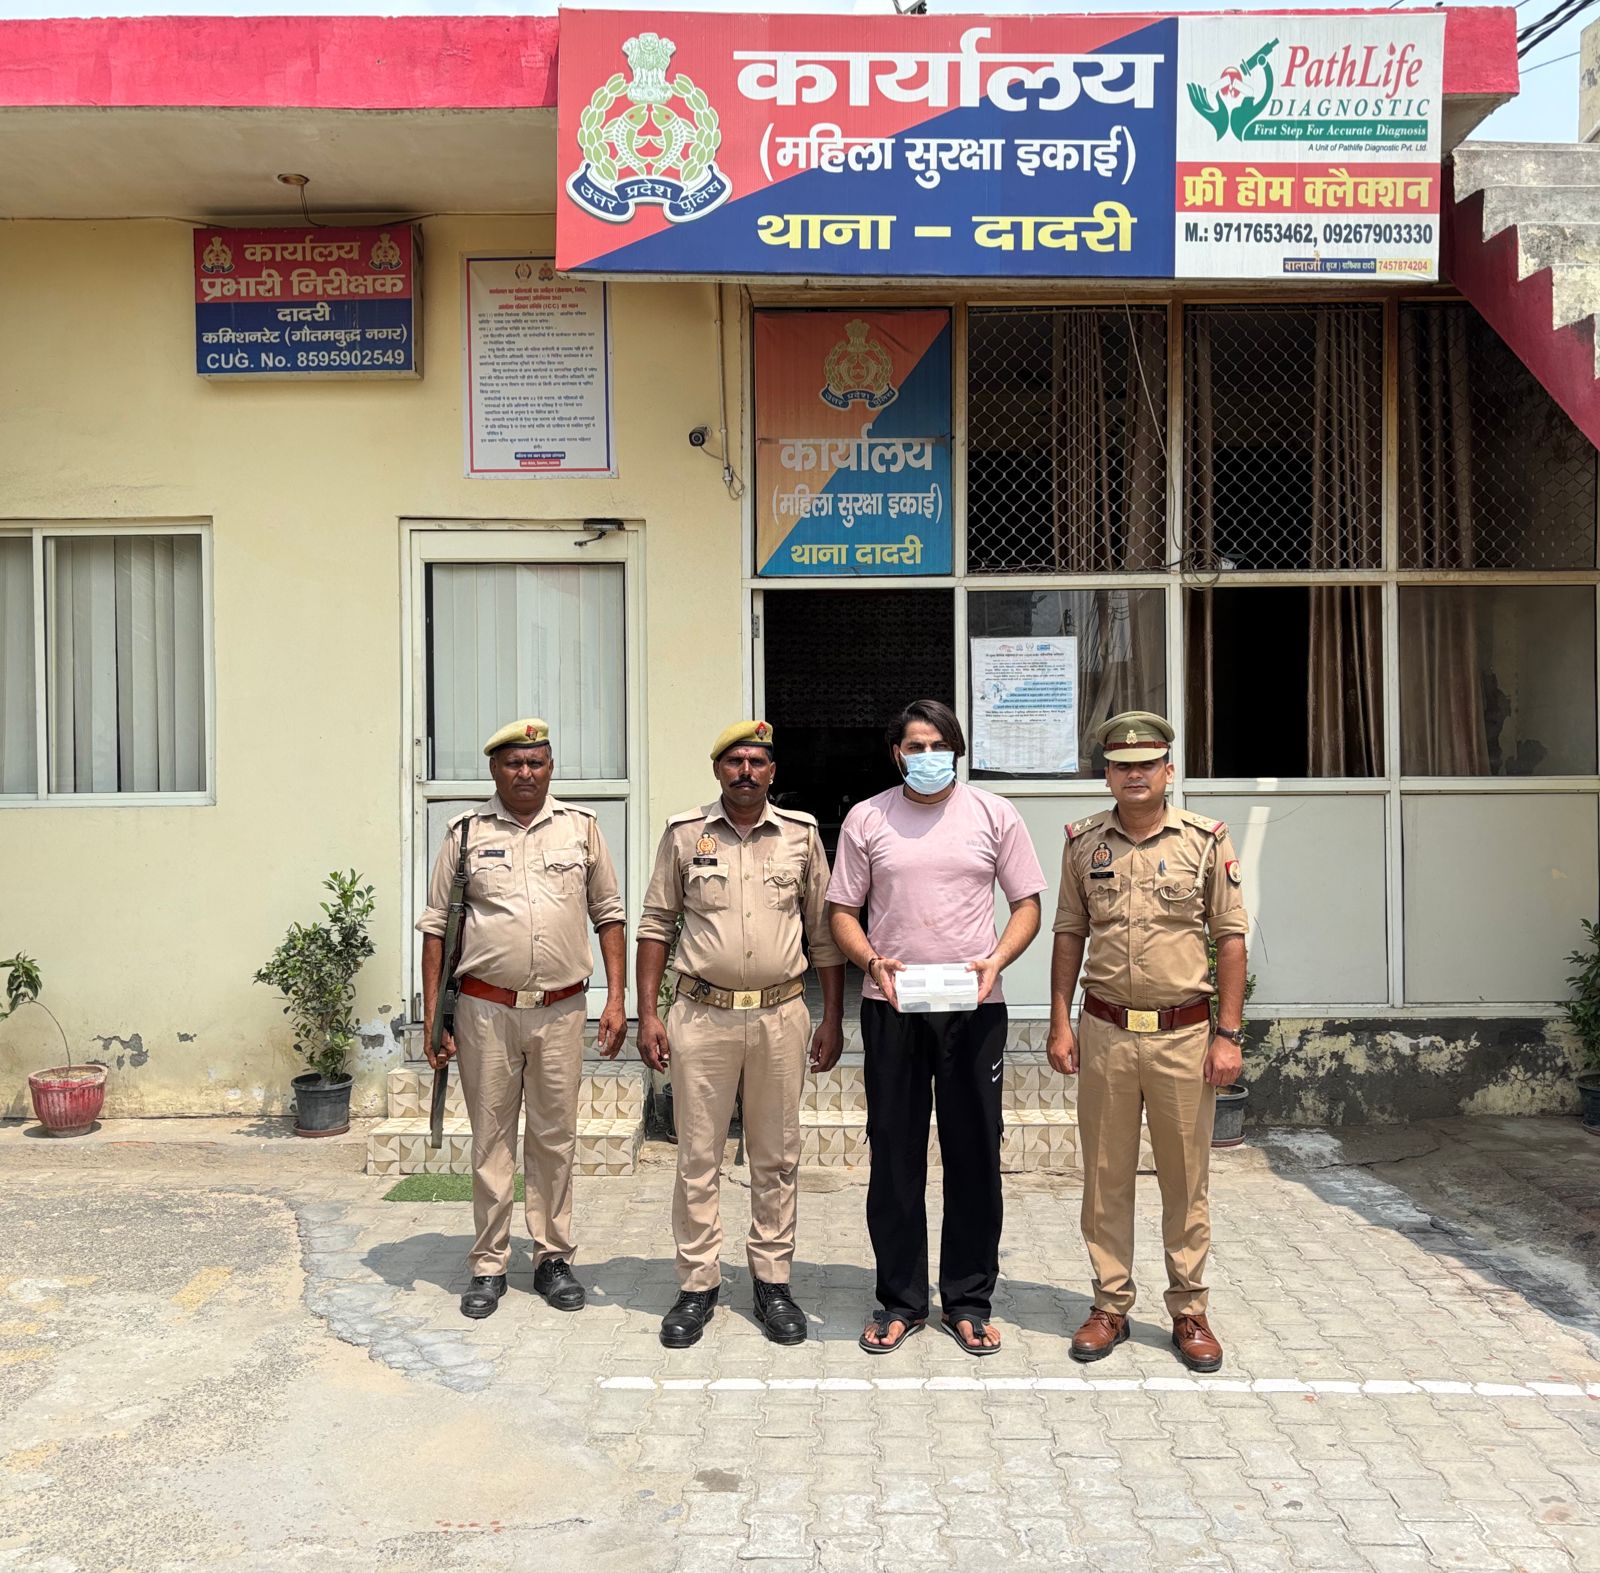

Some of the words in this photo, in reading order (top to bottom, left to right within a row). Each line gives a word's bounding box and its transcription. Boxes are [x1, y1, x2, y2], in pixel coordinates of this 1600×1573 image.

[733, 27, 1164, 113] कार्यालय
[1280, 42, 1423, 99] PathLife
[1269, 98, 1430, 117] DIAGNOSTIC
[1254, 123, 1277, 136] First
[1280, 123, 1303, 139] Step
[1307, 123, 1324, 136] For
[1326, 124, 1373, 137] Accurate
[1376, 123, 1426, 139] Diagnosis
[759, 122, 894, 184] (महिला
[905, 138, 1003, 189] सुरक्षा
[1015, 125, 1137, 185] इकाई)
[1308, 143, 1314, 151] A
[1315, 143, 1329, 151] Unit
[1330, 143, 1337, 151] of
[1338, 143, 1363, 151] Pathlife
[1364, 143, 1399, 152] Diagnostic
[580, 182, 618, 212] उत्तर
[624, 179, 672, 198] प्रदेश
[679, 180, 722, 215] पुलिस
[1183, 166, 1227, 208] फ्री
[1236, 167, 1295, 208] होम
[757, 213, 897, 250] थाना
[972, 200, 1137, 253] दादरी
[1185, 222, 1209, 242] M.:
[1213, 222, 1318, 248] 9717653462,
[1323, 223, 1433, 244] 09267903330
[243, 235, 360, 262] कार्यालय
[200, 268, 283, 302] प्रभारी
[290, 267, 406, 296] निरीक्षक
[277, 302, 331, 322] दादरी
[202, 327, 280, 344] कमिशनरेट
[365, 324, 407, 344] नगर)
[206, 352, 254, 369] CUG.
[261, 352, 291, 368] No.
[297, 349, 404, 367] 8595902549
[779, 423, 935, 473] कार्यालय
[772, 484, 833, 525] (महिला
[838, 492, 882, 528] सुरक्षा
[887, 483, 942, 524] इकाई)
[791, 543, 849, 565] थाना
[855, 535, 923, 565] दादरी
